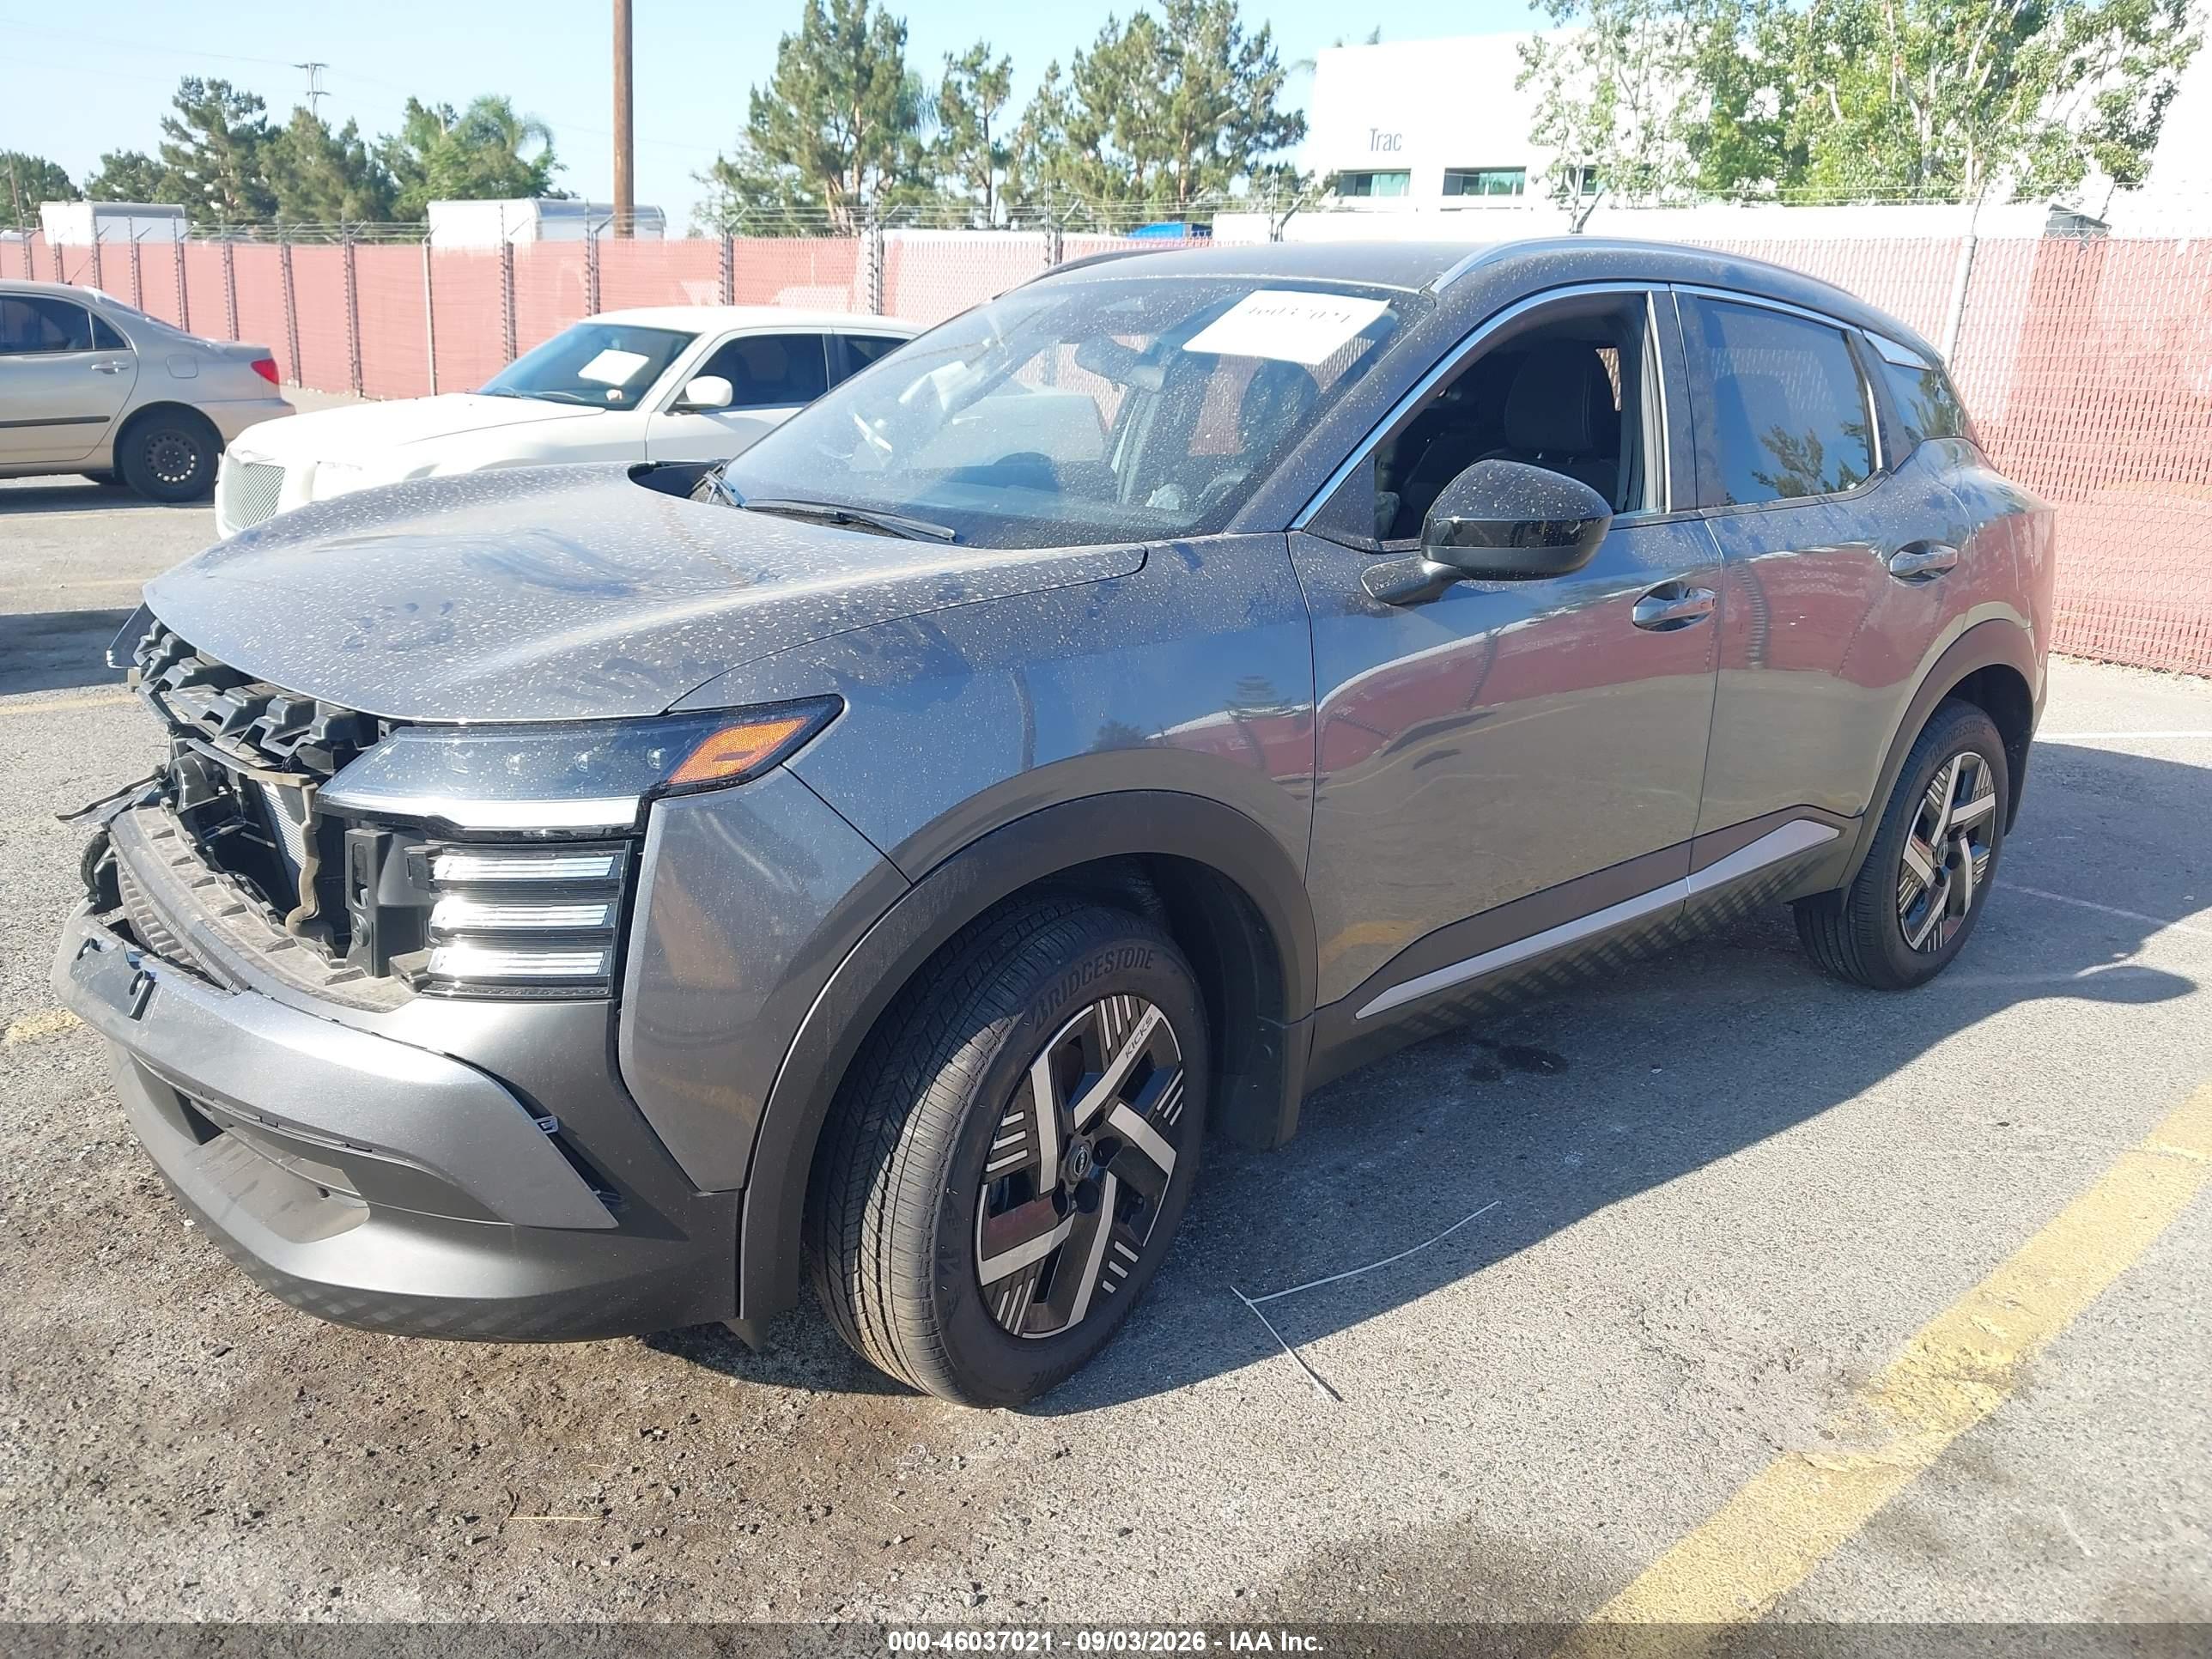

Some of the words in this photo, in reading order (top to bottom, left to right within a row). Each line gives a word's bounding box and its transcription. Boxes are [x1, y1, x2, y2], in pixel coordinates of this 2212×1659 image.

[1369, 127, 1402, 152] Trac
[1031, 946, 1155, 1033] BRIDGESTONE
[1124, 1014, 1153, 1060] KICKS
